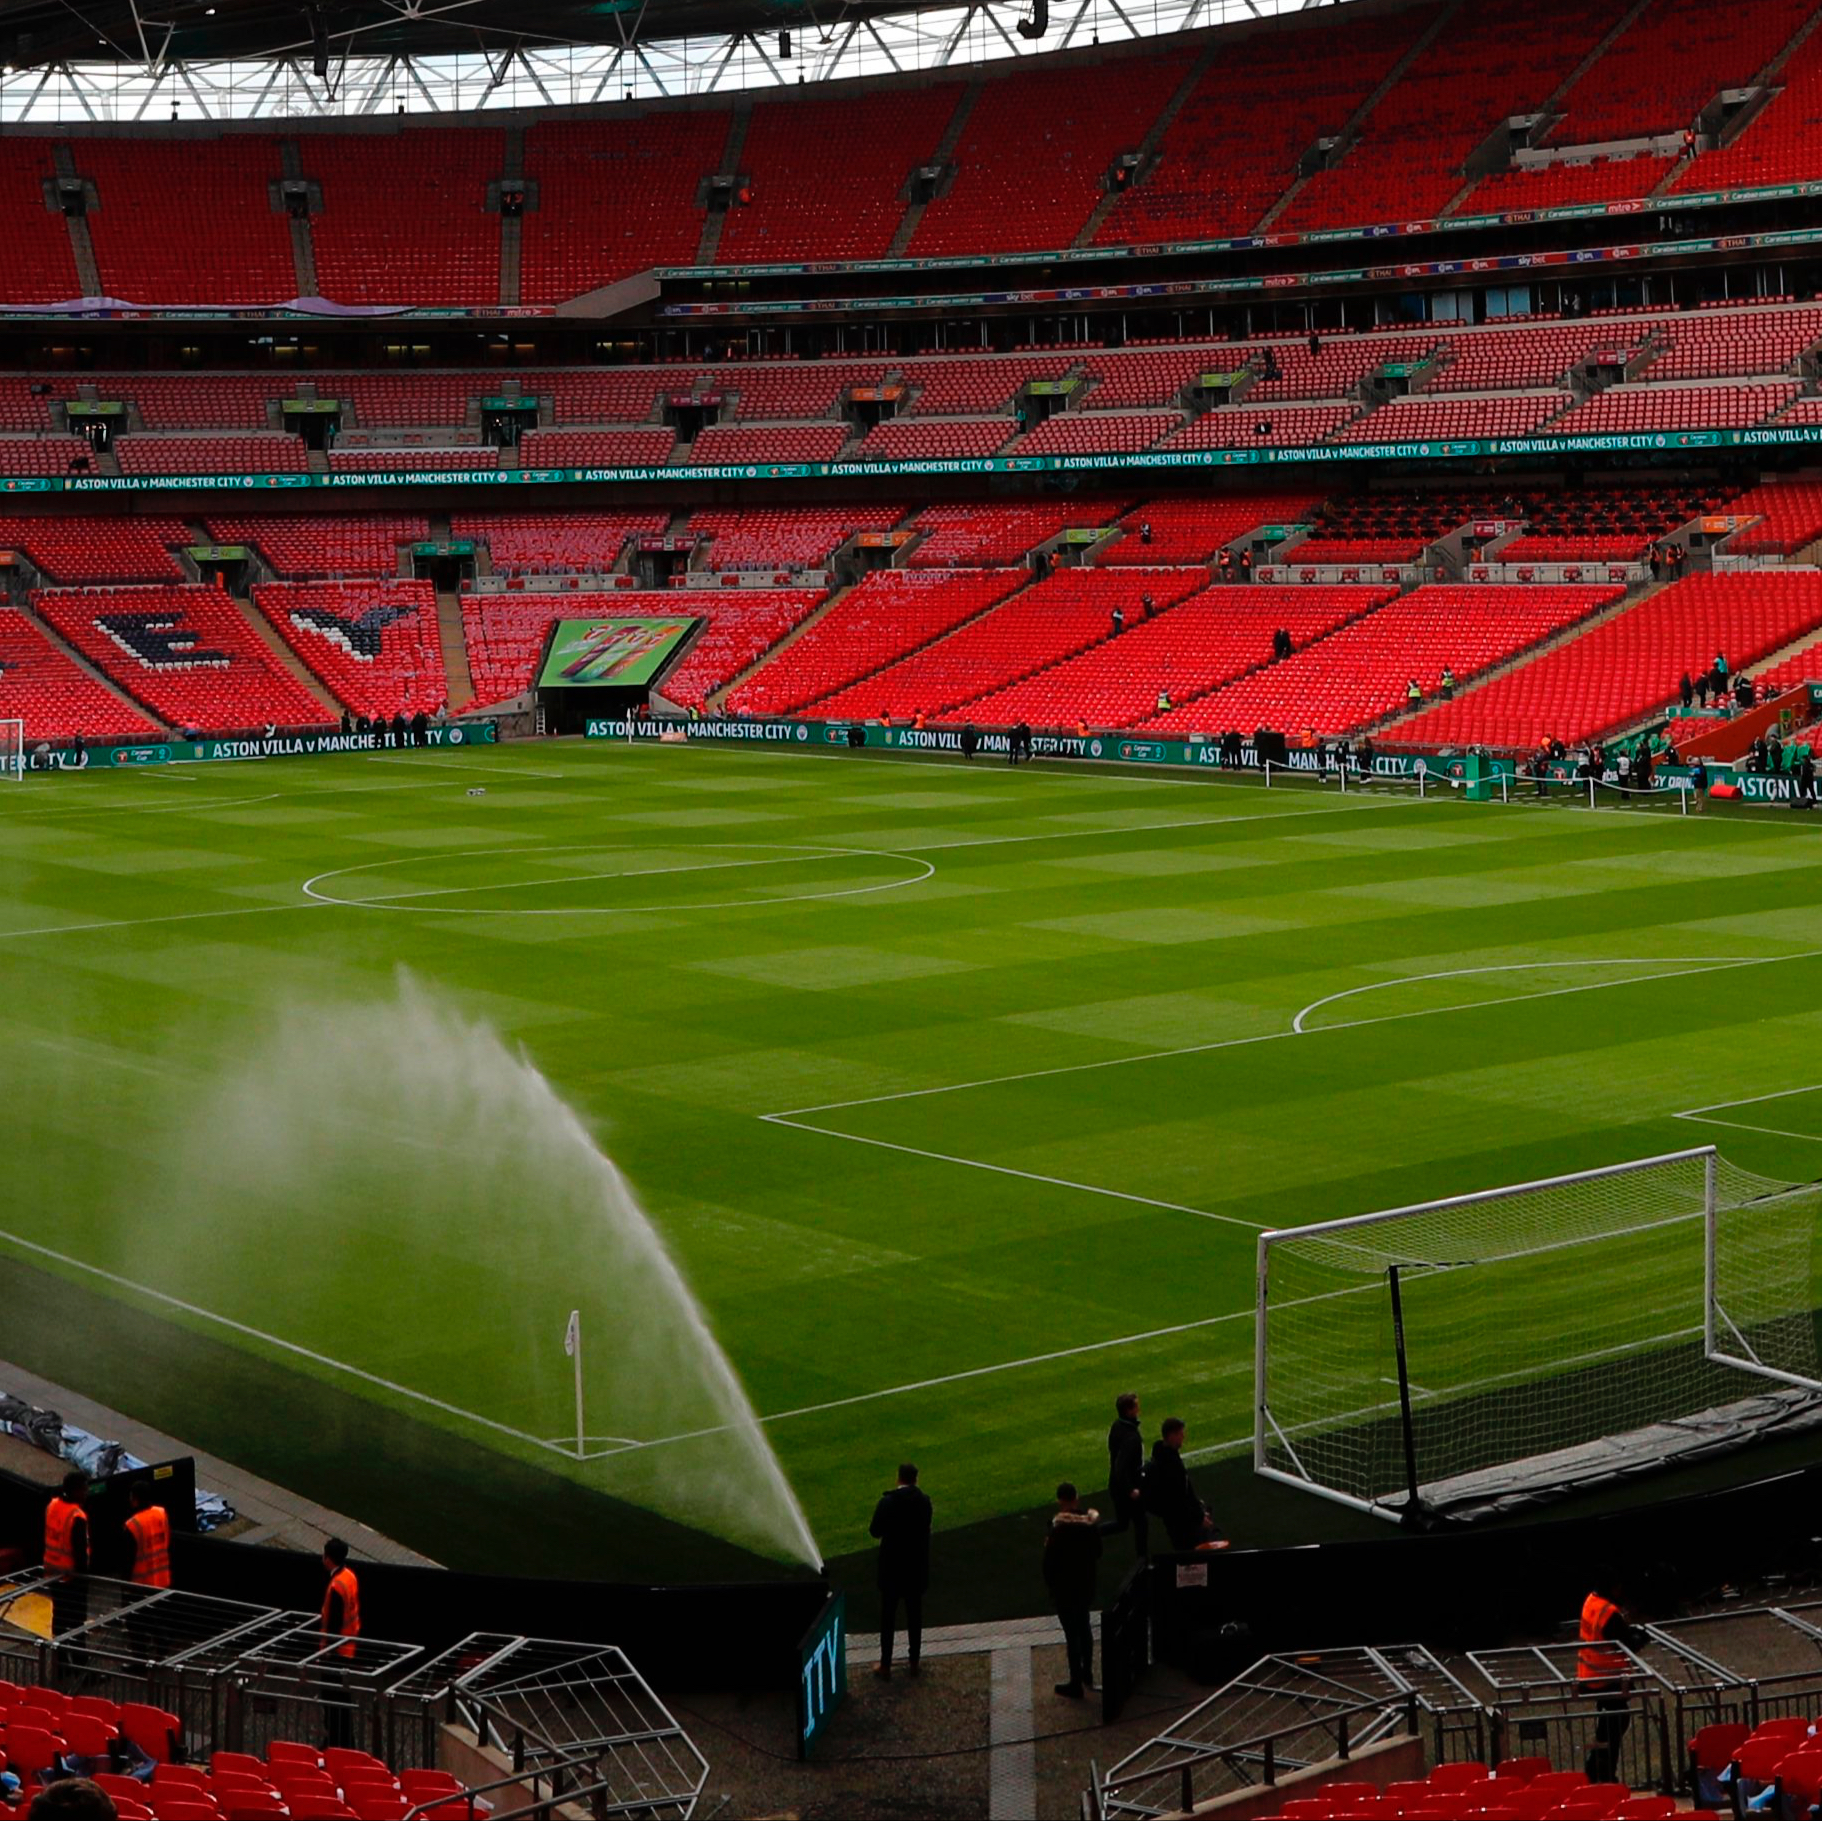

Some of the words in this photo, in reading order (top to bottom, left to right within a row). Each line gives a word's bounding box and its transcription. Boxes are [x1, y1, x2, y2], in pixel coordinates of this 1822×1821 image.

[1744, 431, 1776, 442] ASTON
[1778, 430, 1809, 441] VILLA
[586, 470, 617, 479] ASTON
[619, 470, 647, 479] VILLA
[657, 468, 719, 478] MANCHESTER
[722, 468, 743, 477] CITY
[76, 479, 108, 489] ASTON
[110, 479, 139, 488] VILLA
[150, 478, 215, 487] MANCHESTER
[218, 478, 240, 487] CITY
[588, 721, 634, 737] ASTON
[637, 721, 674, 737] VILLA
[687, 722, 764, 739] MANCHESTER
[765, 725, 791, 739] CITY
[898, 730, 937, 748] ASTON
[213, 739, 260, 759] ASTON
[262, 737, 303, 756] VILLA
[306, 741, 316, 752] v
[1376, 756, 1407, 775] CITY
[1737, 776, 1789, 801] ASTON
